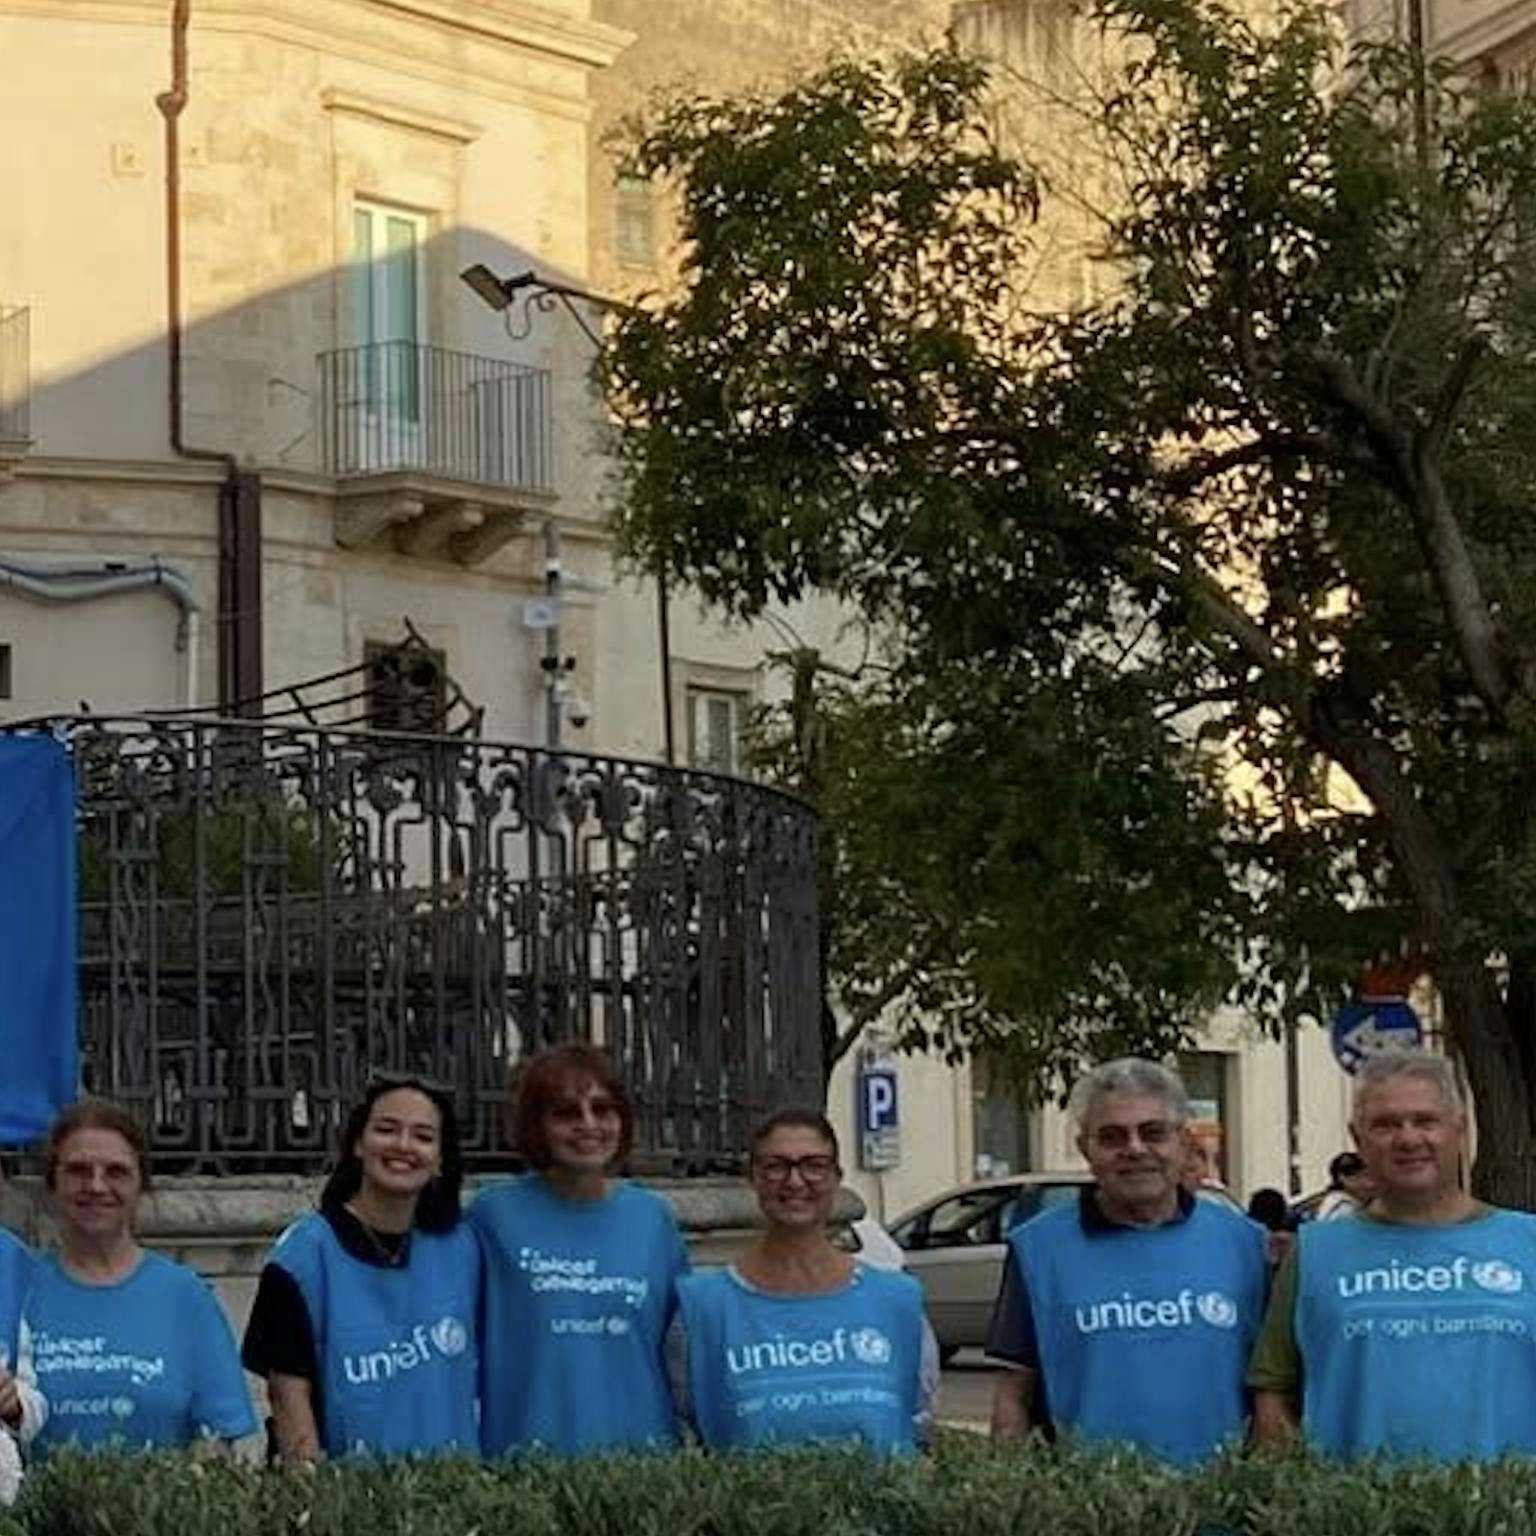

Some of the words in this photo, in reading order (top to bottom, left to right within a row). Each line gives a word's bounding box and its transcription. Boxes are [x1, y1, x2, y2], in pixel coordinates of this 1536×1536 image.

[869, 1077, 893, 1130] P
[1338, 1256, 1469, 1298] unicef
[1075, 1289, 1198, 1333] unicef
[1382, 1317, 1428, 1338] ogni
[1433, 1314, 1528, 1336] bambino
[343, 1324, 431, 1384] unief
[727, 1327, 846, 1373] unicef
